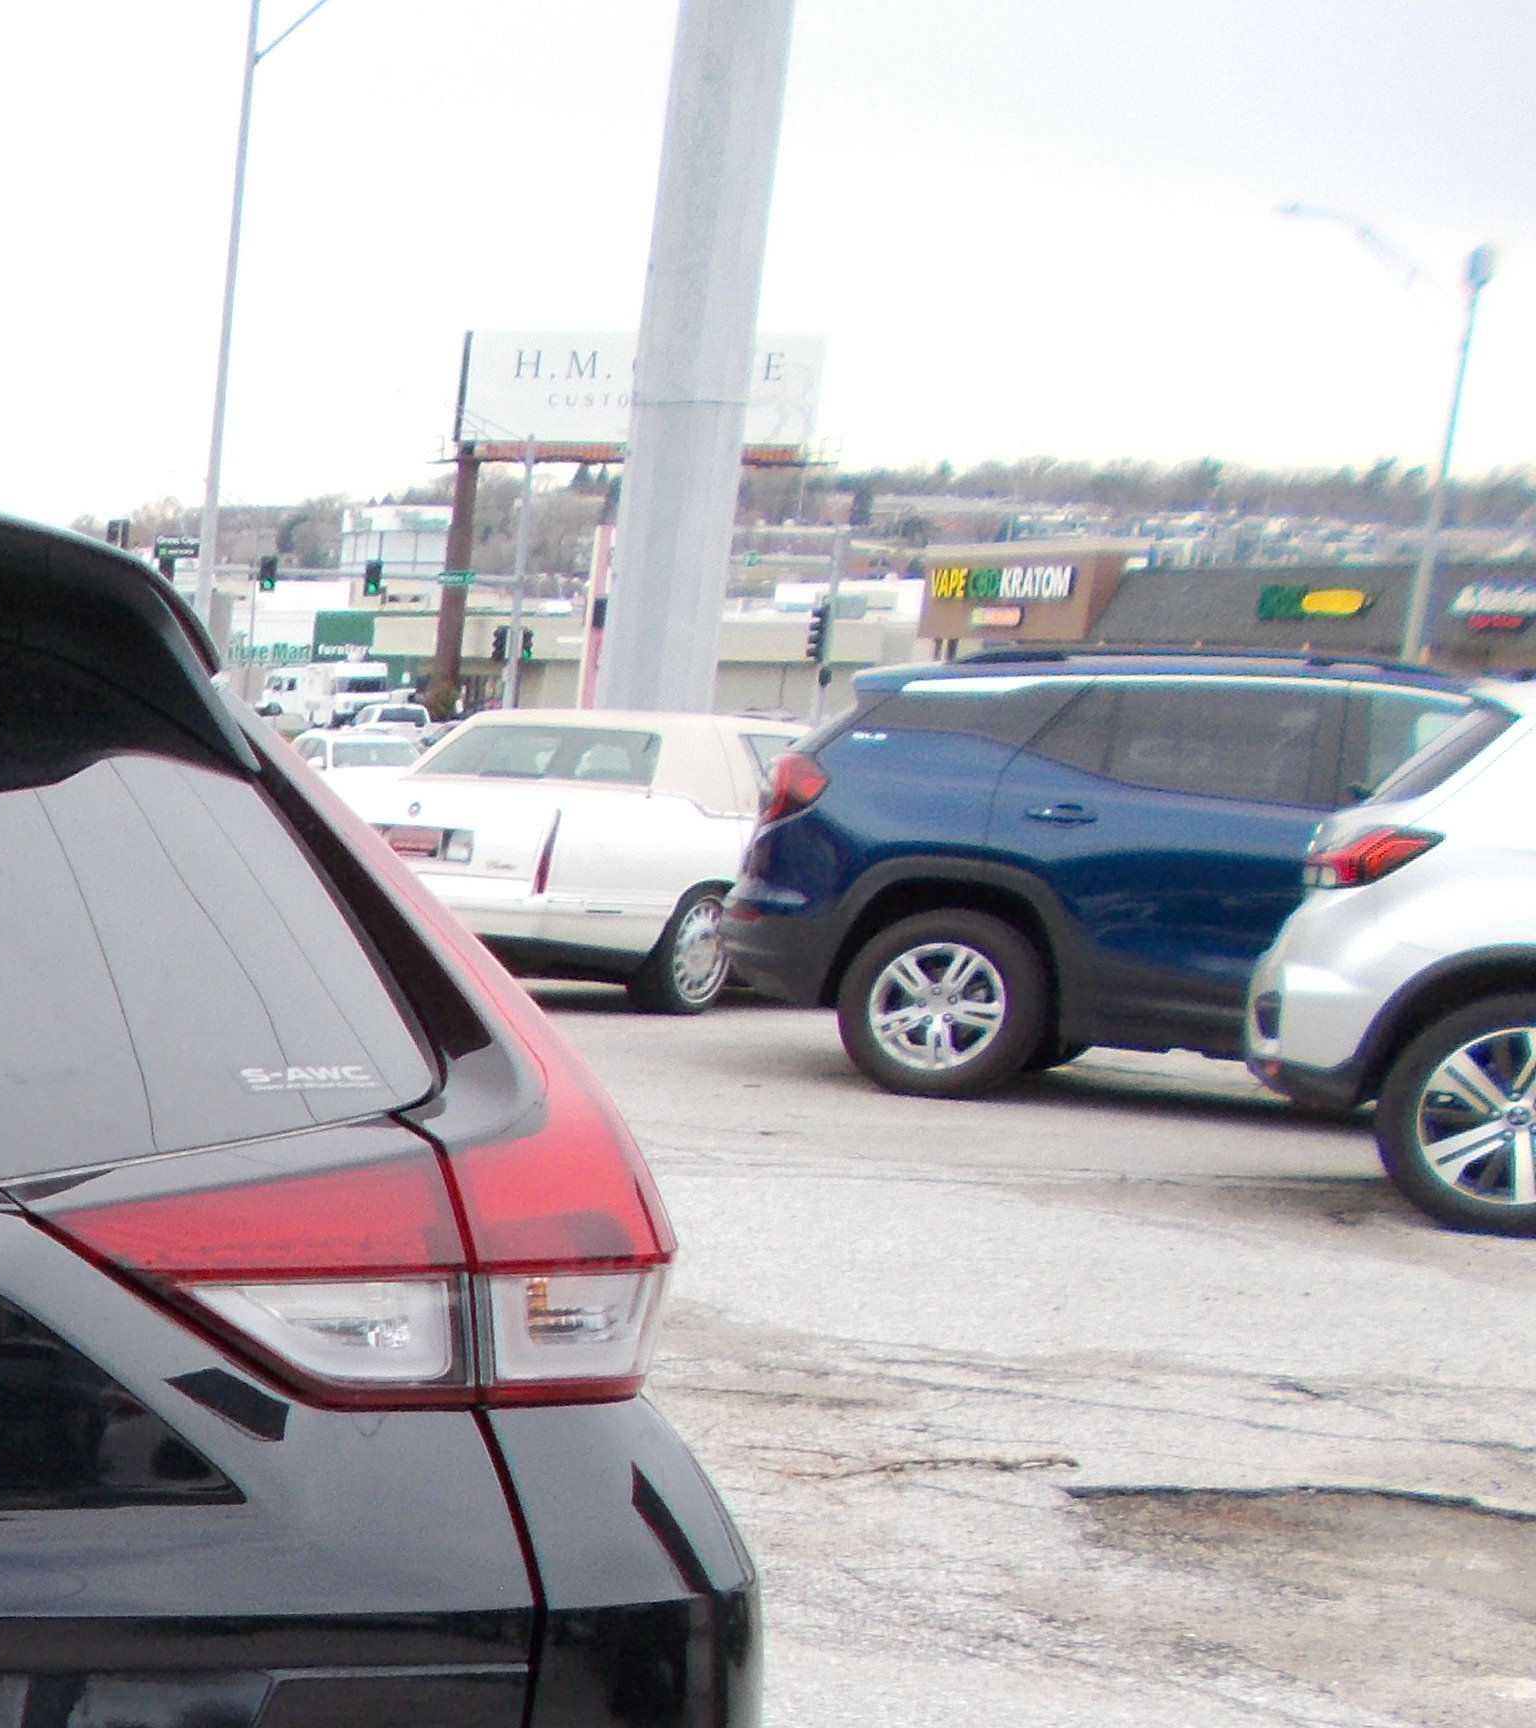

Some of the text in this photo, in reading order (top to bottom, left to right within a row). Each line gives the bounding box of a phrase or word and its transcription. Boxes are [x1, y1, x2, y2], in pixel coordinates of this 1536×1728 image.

[547, 391, 630, 408] CUSTO
[930, 567, 968, 598] VAPE
[999, 565, 1073, 599] KRATOM
[240, 1066, 370, 1084] S-AWC
